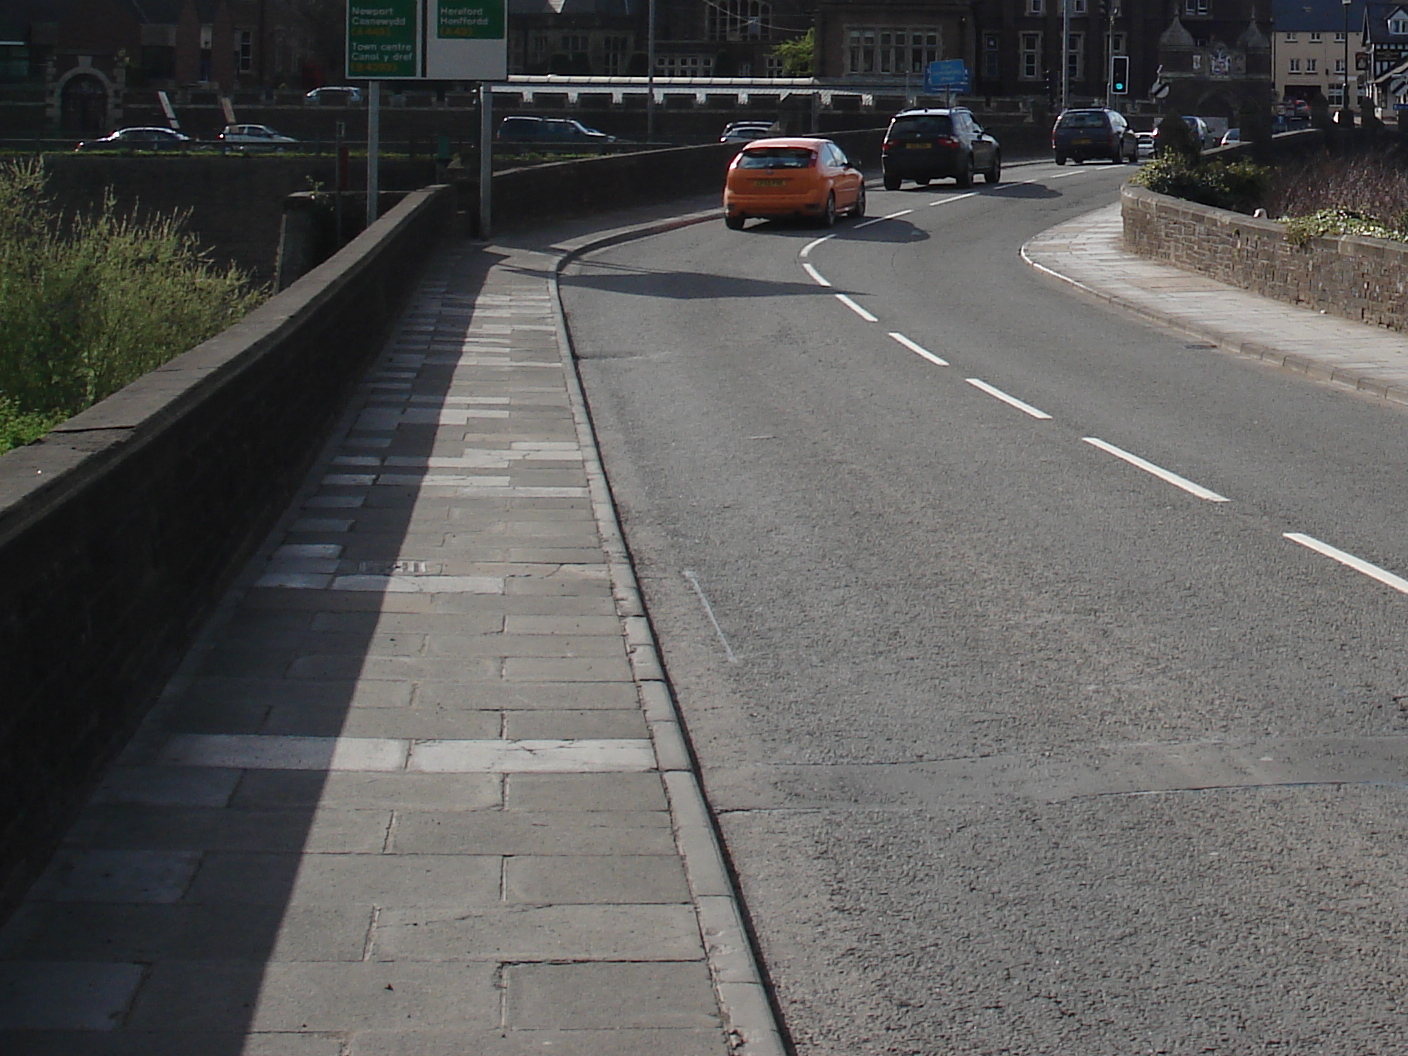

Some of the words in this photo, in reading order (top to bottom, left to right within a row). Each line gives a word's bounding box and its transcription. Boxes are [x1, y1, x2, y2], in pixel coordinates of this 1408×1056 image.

[352, 6, 394, 16] Newport
[440, 7, 483, 16] Hereford
[352, 17, 406, 26] Casnewydd
[440, 17, 488, 26] Henffordd
[352, 42, 377, 50] Town
[380, 42, 412, 51] centre
[352, 52, 380, 60] Canol
[392, 52, 412, 60] dref
